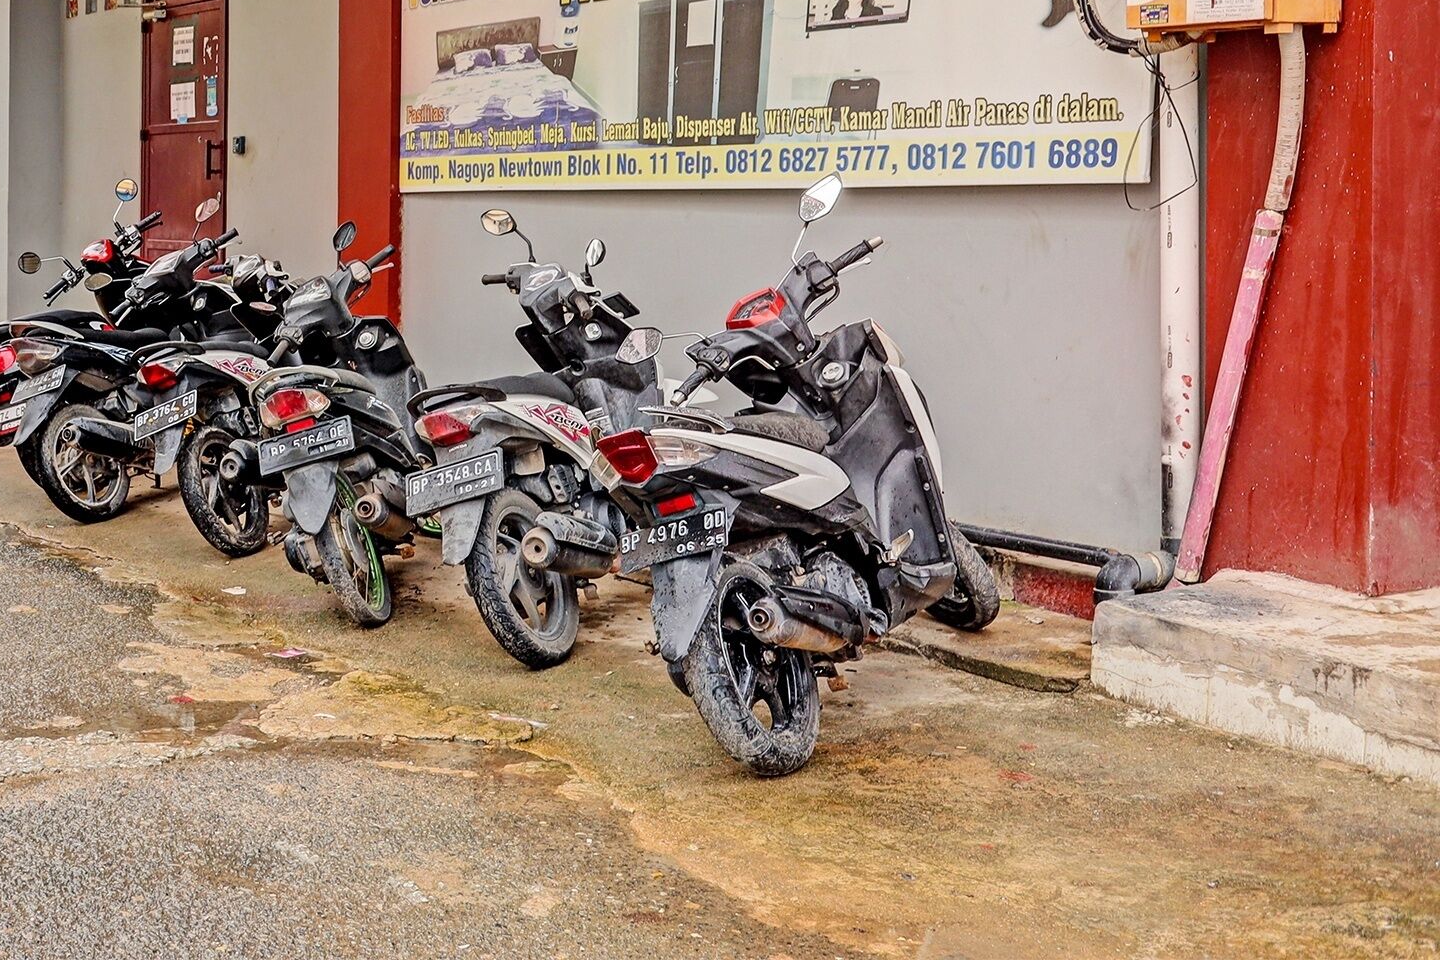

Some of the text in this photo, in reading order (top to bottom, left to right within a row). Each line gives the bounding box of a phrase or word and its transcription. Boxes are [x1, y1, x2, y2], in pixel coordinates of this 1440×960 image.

[420, 131, 431, 150] TV
[453, 127, 485, 148] Kulkas,
[487, 124, 537, 150] Springbed,
[570, 120, 599, 144] Kursi,
[602, 119, 640, 141] Lemari
[675, 113, 736, 143] Dispenser
[739, 111, 760, 138] Air,
[764, 107, 835, 136] Wifi/CCTV,
[839, 105, 888, 132] Kamar
[891, 100, 943, 129] Mandi
[946, 98, 971, 128] Air
[974, 97, 1029, 126] Panas
[1033, 94, 1052, 124] di
[1057, 92, 1124, 123] dalam.
[407, 161, 444, 184] Komp.
[448, 160, 495, 183] Nagoya
[499, 157, 563, 179] Newtown
[568, 155, 601, 176] Blok
[616, 153, 642, 175] No.
[649, 152, 668, 174] 11
[676, 150, 718, 179] Telp.
[725, 148, 772, 174] 0812
[779, 147, 829, 172] 6827
[907, 142, 967, 170] 0812
[976, 140, 1035, 170] 7601
[1048, 138, 1117, 169] 6889
[137, 413, 150, 428] BP
[152, 401, 178, 420] 3764
[412, 477, 429, 495] BP
[436, 465, 469, 486] 3548
[621, 533, 640, 554] BP
[647, 520, 688, 544] 4976
